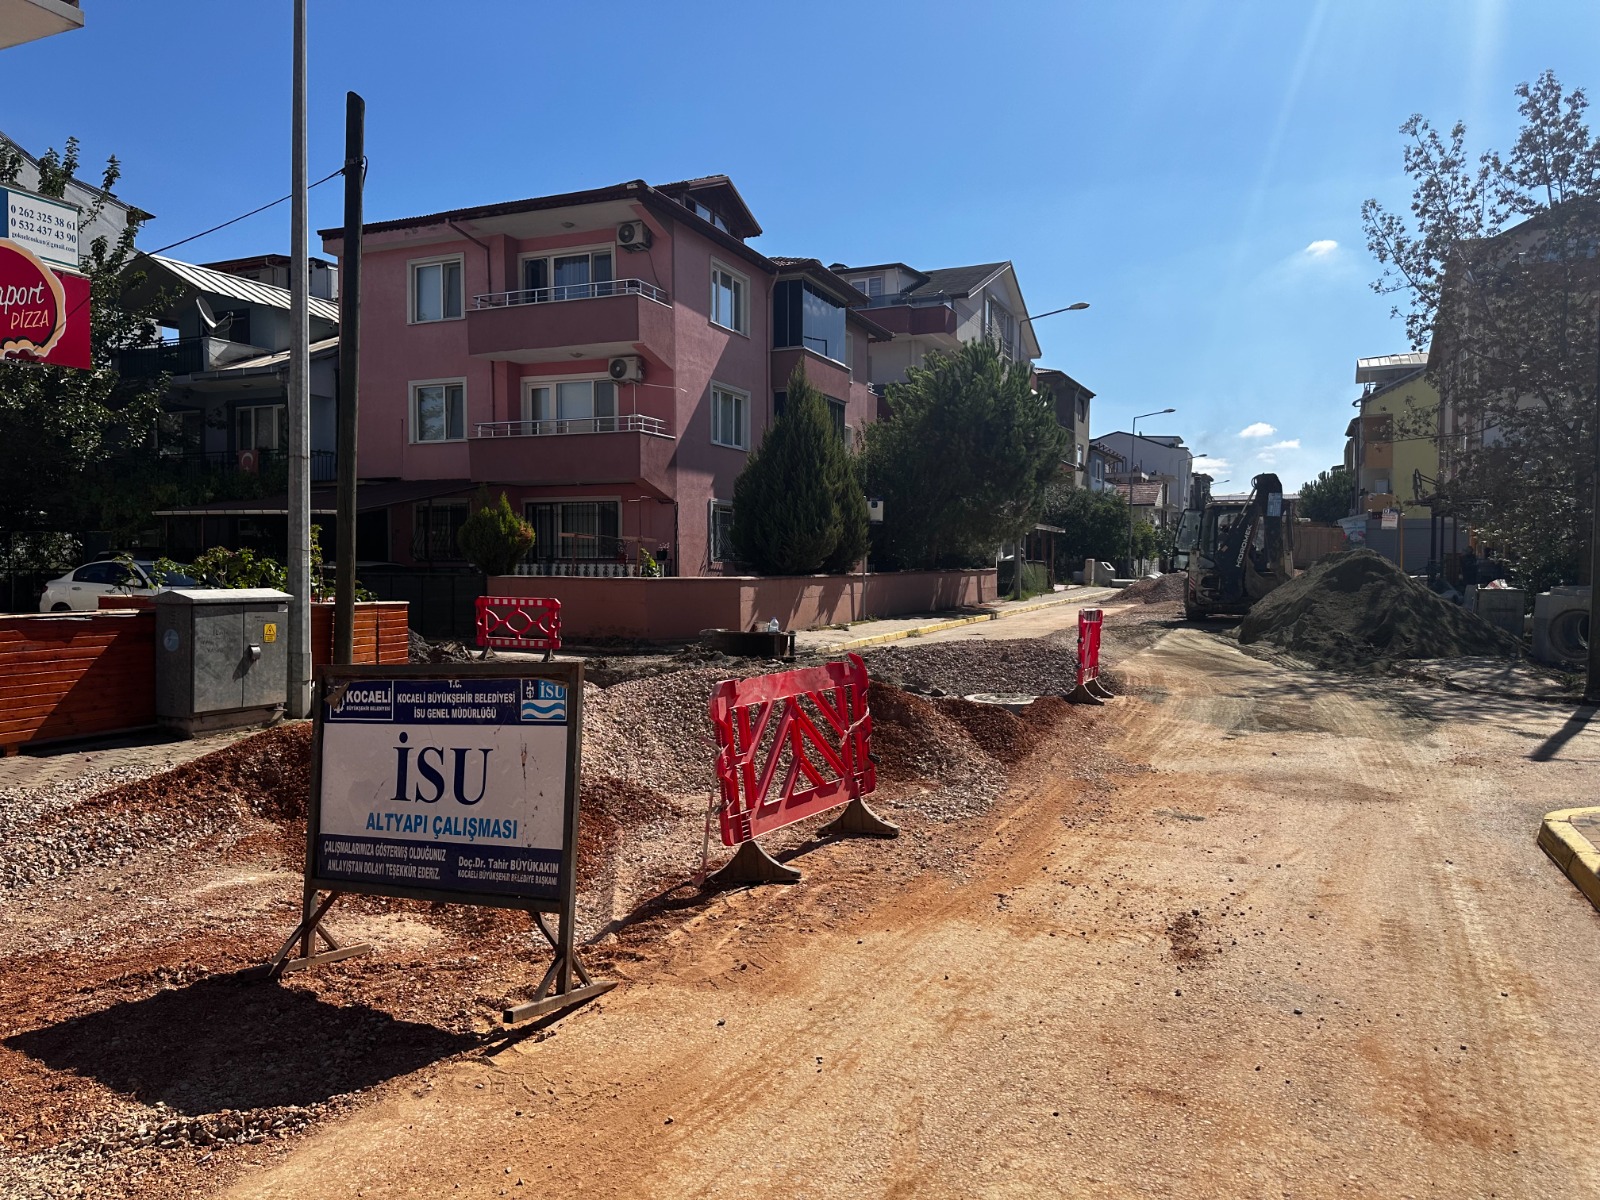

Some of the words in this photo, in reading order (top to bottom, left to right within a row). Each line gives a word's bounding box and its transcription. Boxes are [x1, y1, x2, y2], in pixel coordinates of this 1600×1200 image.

[11, 205, 16, 214] 0
[19, 207, 34, 219] 262
[37, 212, 52, 224] 325
[55, 217, 64, 228] 38
[67, 221, 75, 231] 61
[11, 218, 16, 227] 0
[19, 221, 34, 232] 532
[37, 226, 52, 237] 437
[55, 230, 64, 240] 43
[67, 233, 76, 243] 90
[448, 679, 462, 689] T.C.
[540, 681, 564, 699] İSU
[346, 688, 391, 704] KOCAELİ
[397, 691, 426, 704] KOCAELİ
[427, 691, 473, 706] BÜYÜKŞEHİR
[474, 691, 516, 704] BELEDİYESİ
[414, 706, 426, 719] İSU
[427, 708, 450, 719] GENEL
[451, 707, 497, 719] MÜDÜRLÜĞÜ
[390, 731, 494, 806] İSU
[366, 812, 429, 834] ALTYAPI
[432, 815, 518, 841] ÇALIŞMASI
[409, 845, 447, 862] OLDUĞUNUZ
[363, 861, 386, 875] DOLAYI
[385, 863, 418, 879] TEŞEKKÜR
[488, 858, 509, 870] Tahir
[510, 858, 560, 874] BÜYÜKAKIN
